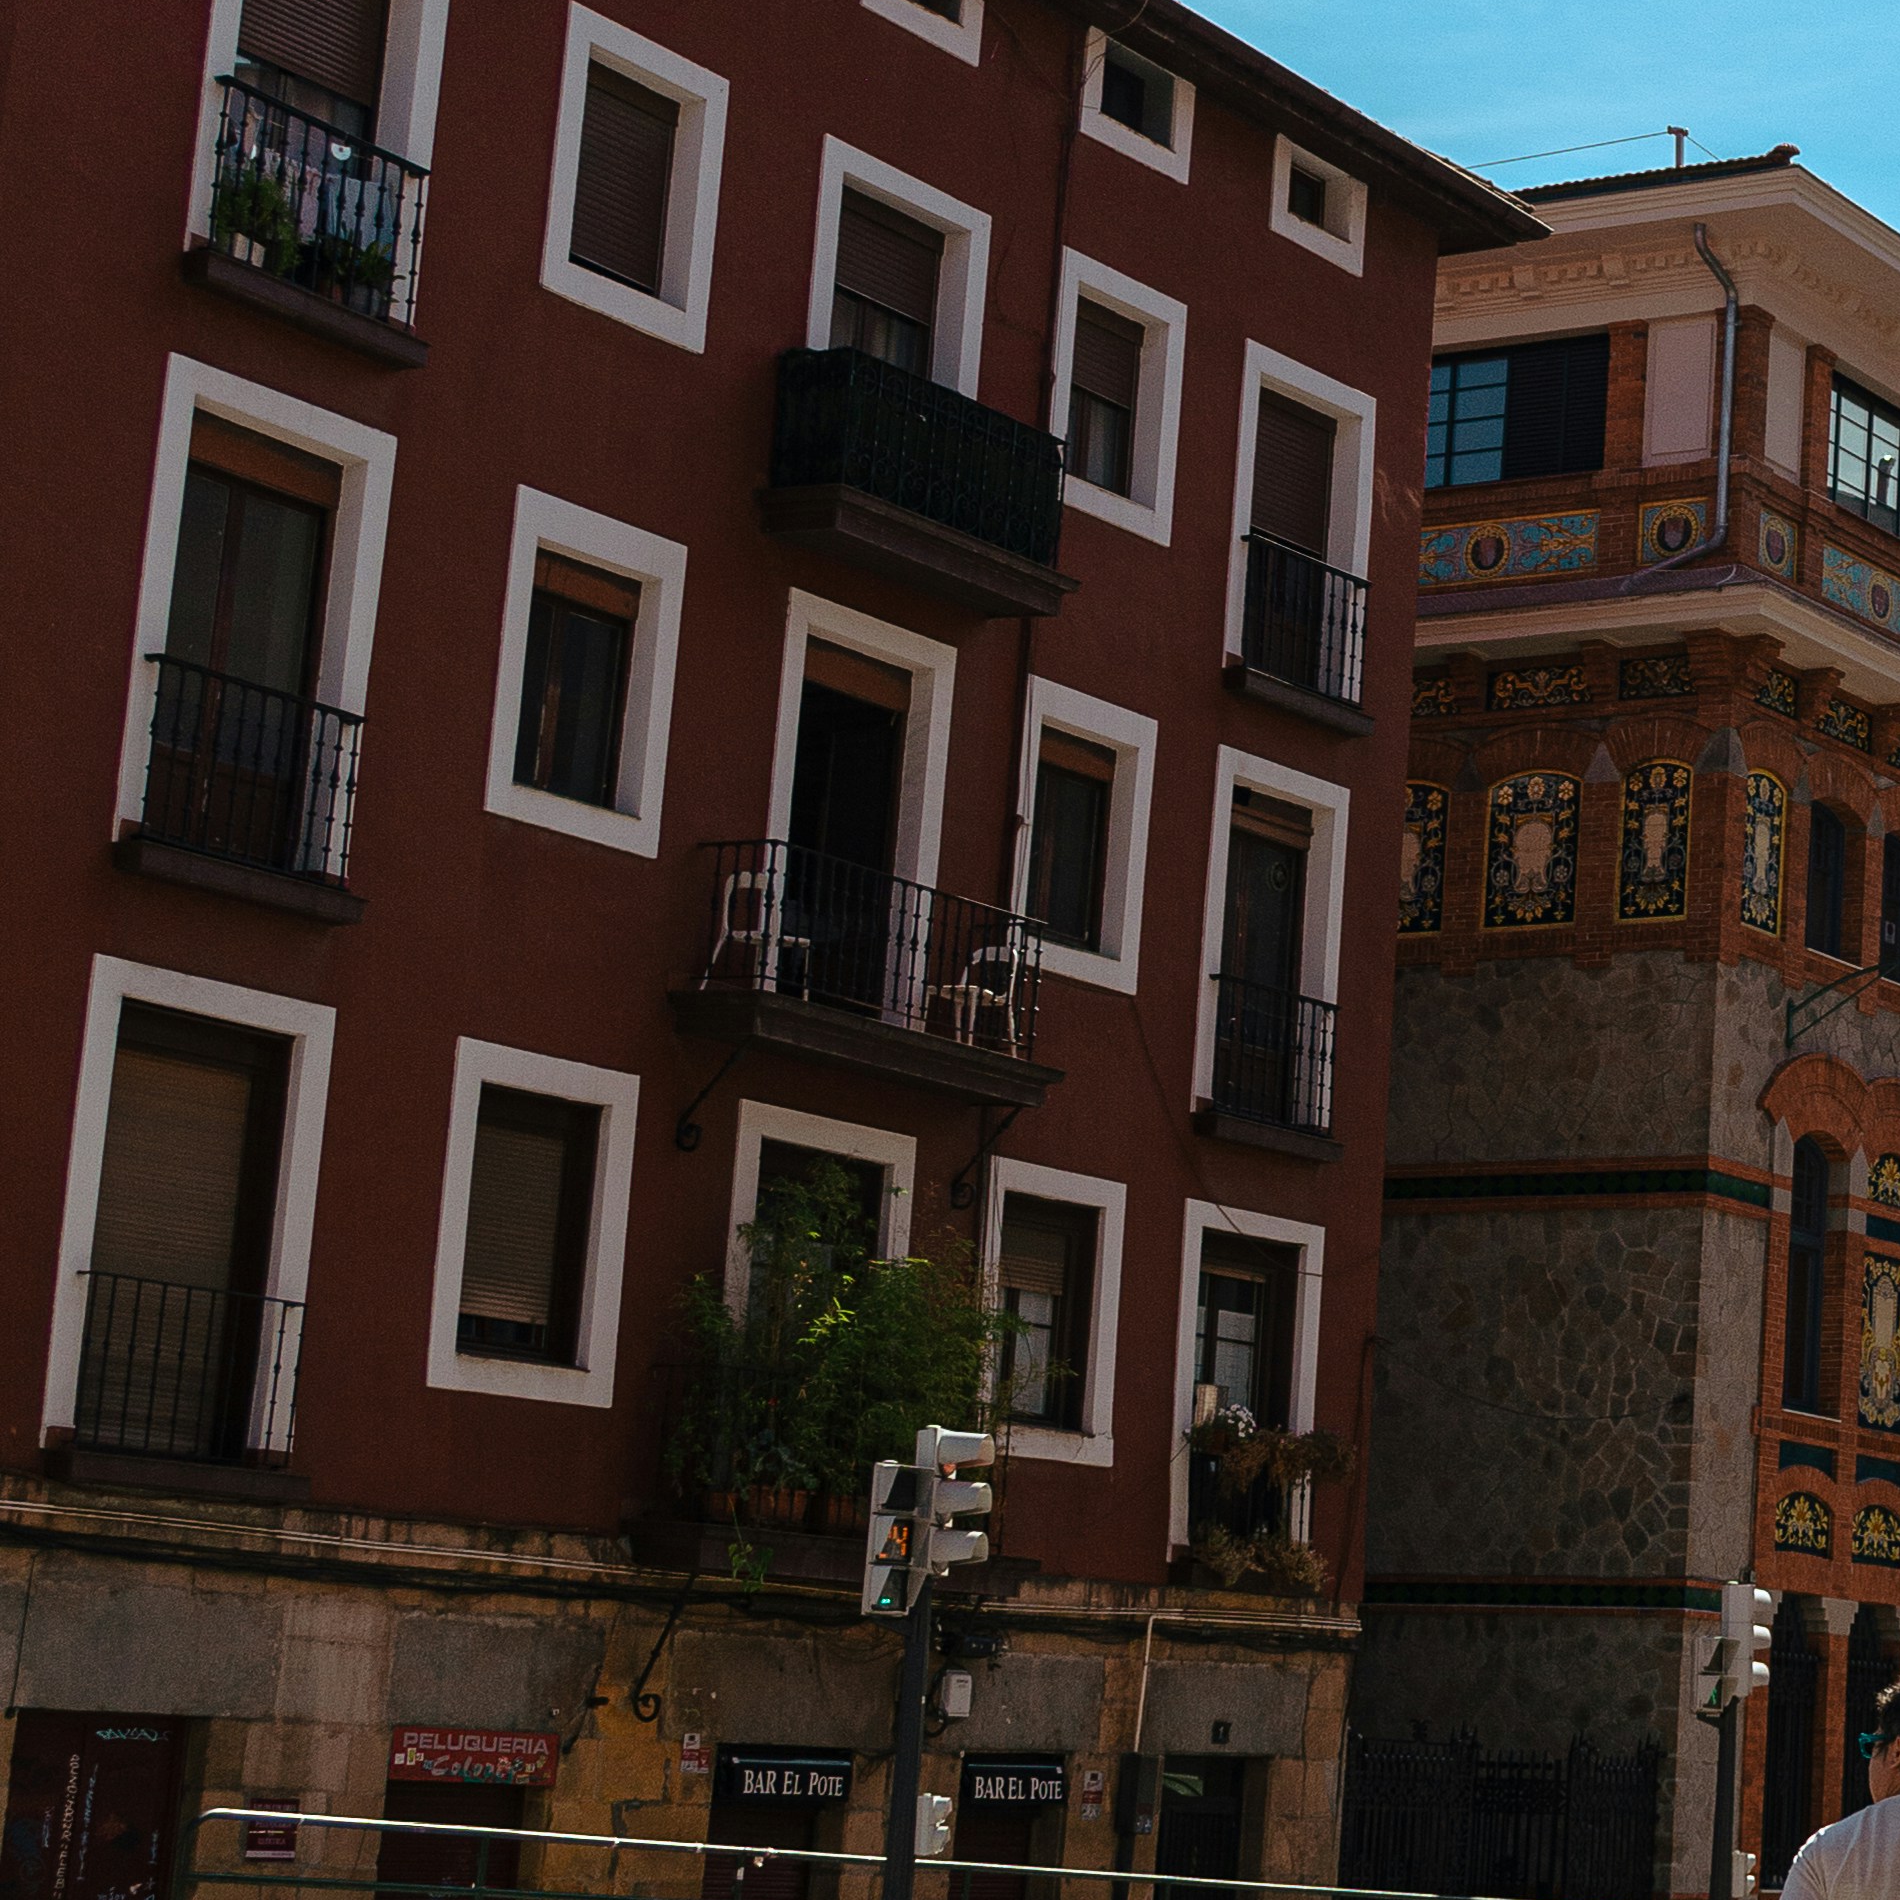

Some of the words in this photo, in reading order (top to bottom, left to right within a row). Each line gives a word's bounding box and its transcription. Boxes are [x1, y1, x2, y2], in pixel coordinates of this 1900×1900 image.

[403, 1731, 550, 1755] PELUQUERIA
[743, 1769, 777, 1795] BAR
[807, 1771, 844, 1797] POTE
[974, 1775, 1005, 1800] BAR
[1030, 1776, 1063, 1801] POTE
